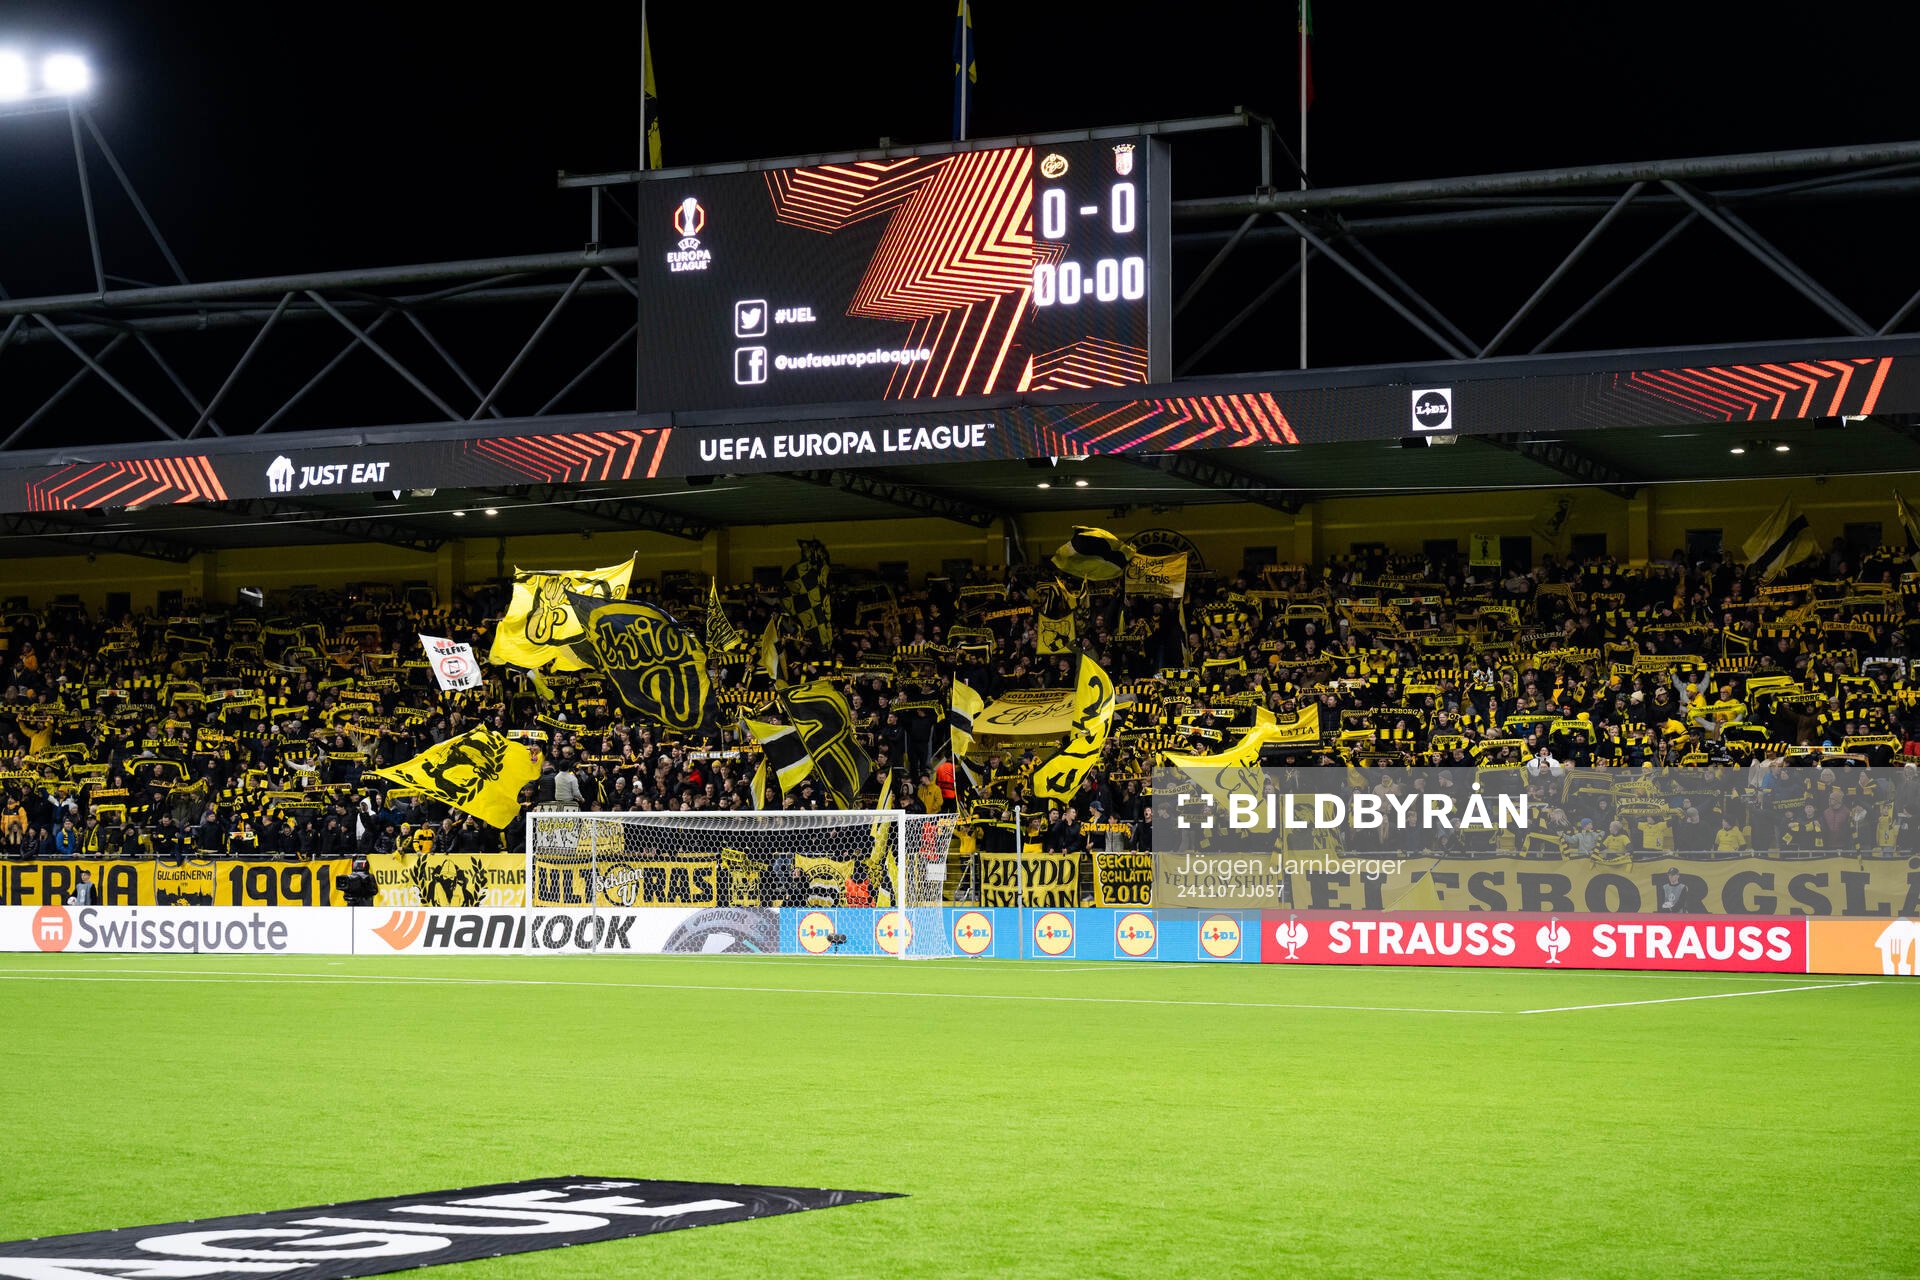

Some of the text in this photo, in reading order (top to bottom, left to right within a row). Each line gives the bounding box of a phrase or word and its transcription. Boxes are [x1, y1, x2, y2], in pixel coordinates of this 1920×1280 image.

[1042, 189, 1066, 239] 0
[1112, 183, 1135, 233] 0
[667, 249, 711, 263] EUROPA
[775, 307, 816, 324] #UEL
[775, 349, 930, 369] @uefaeuropaleague
[700, 437, 767, 461] UEFA
[774, 430, 876, 458] EUROPA
[299, 462, 390, 489] JUST EAT
[986, 701, 1076, 727] Elfsbor
[983, 859, 1076, 887] KRYDD
[1098, 853, 1153, 869] SEKTION
[0, 864, 138, 906] ERA
[157, 870, 213, 881] GULIGANERNA
[229, 863, 331, 906] 1991
[1100, 870, 1154, 884] SCHLÄTTA
[1102, 884, 1150, 903] 2016
[78, 907, 288, 953] Swissquote
[1328, 920, 1516, 956] STRAUSS
[1592, 923, 1792, 962] STRAUSS
